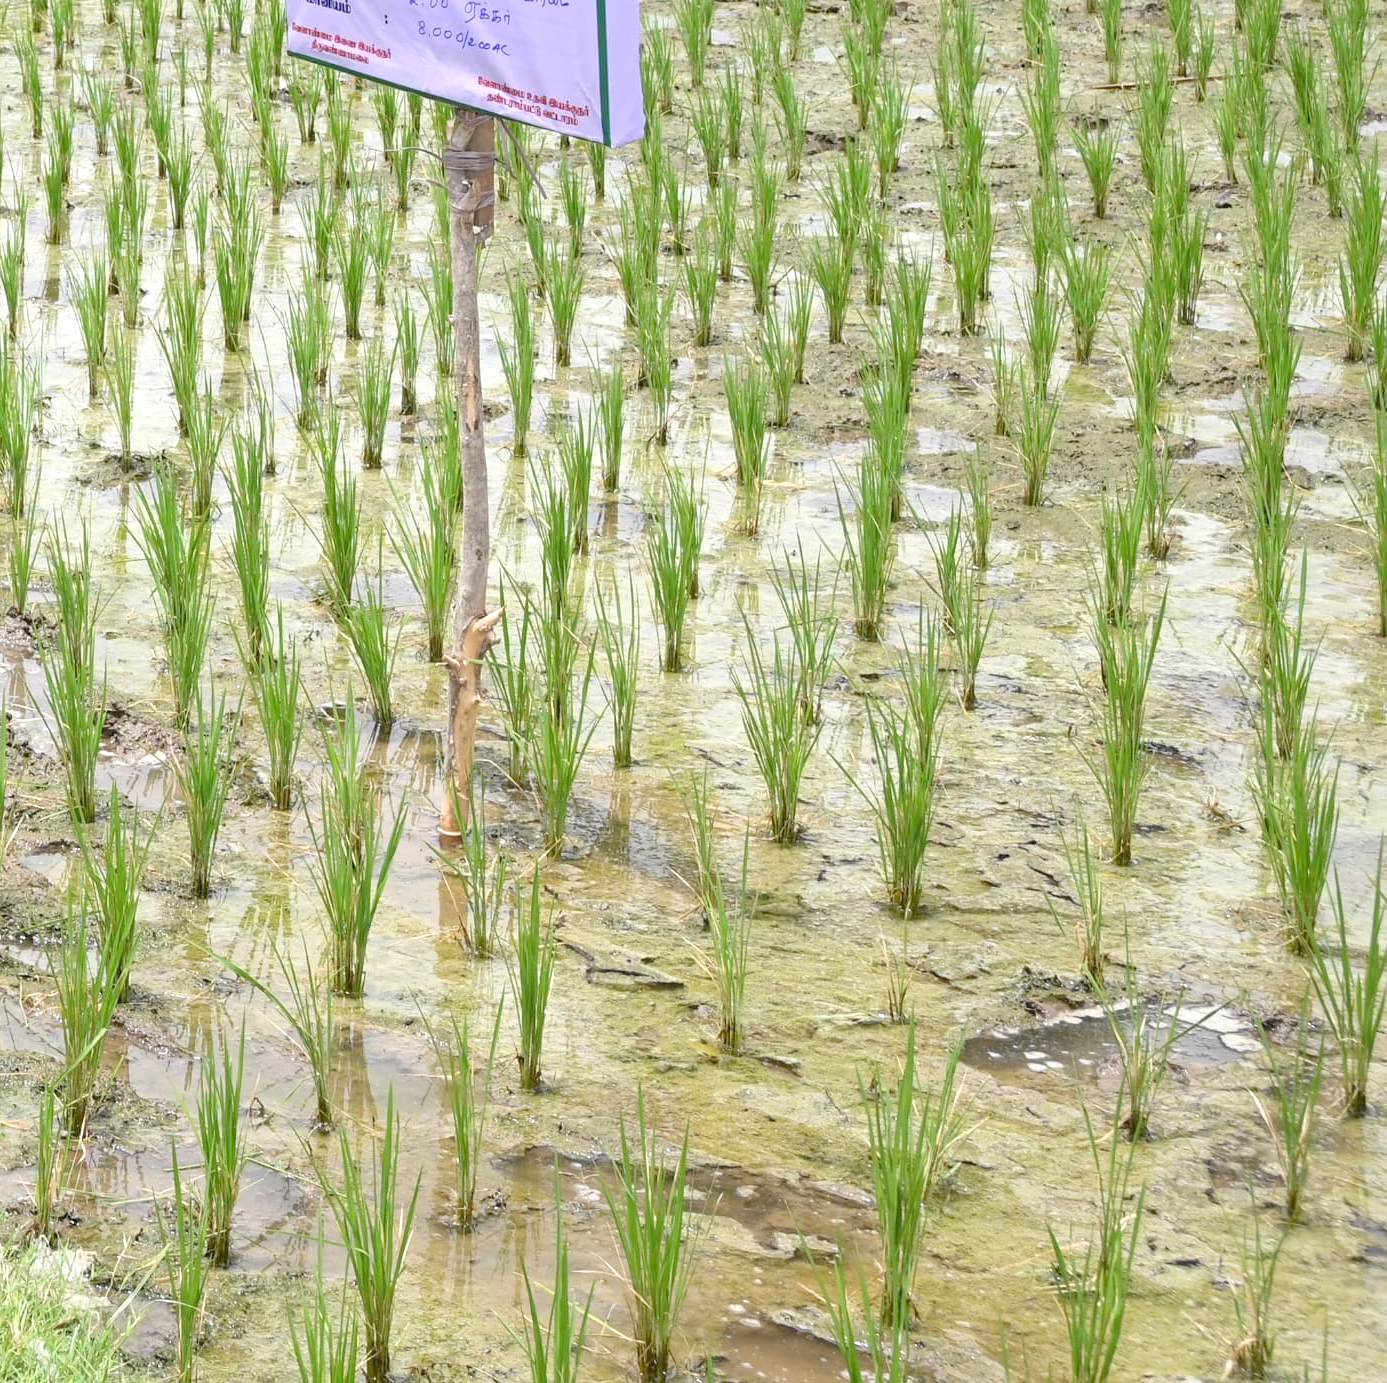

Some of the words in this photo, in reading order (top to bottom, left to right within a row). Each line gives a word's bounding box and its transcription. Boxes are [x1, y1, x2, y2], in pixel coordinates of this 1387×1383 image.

[292, 21, 332, 41] வேளாண்மை
[477, 75, 526, 98] வேளாண்மை
[526, 92, 548, 106] உதவி
[548, 96, 590, 117] இயக்குநர்
[486, 92, 542, 117] தண்டராம்பட்டு
[542, 109, 579, 126] வட்டாரம்
